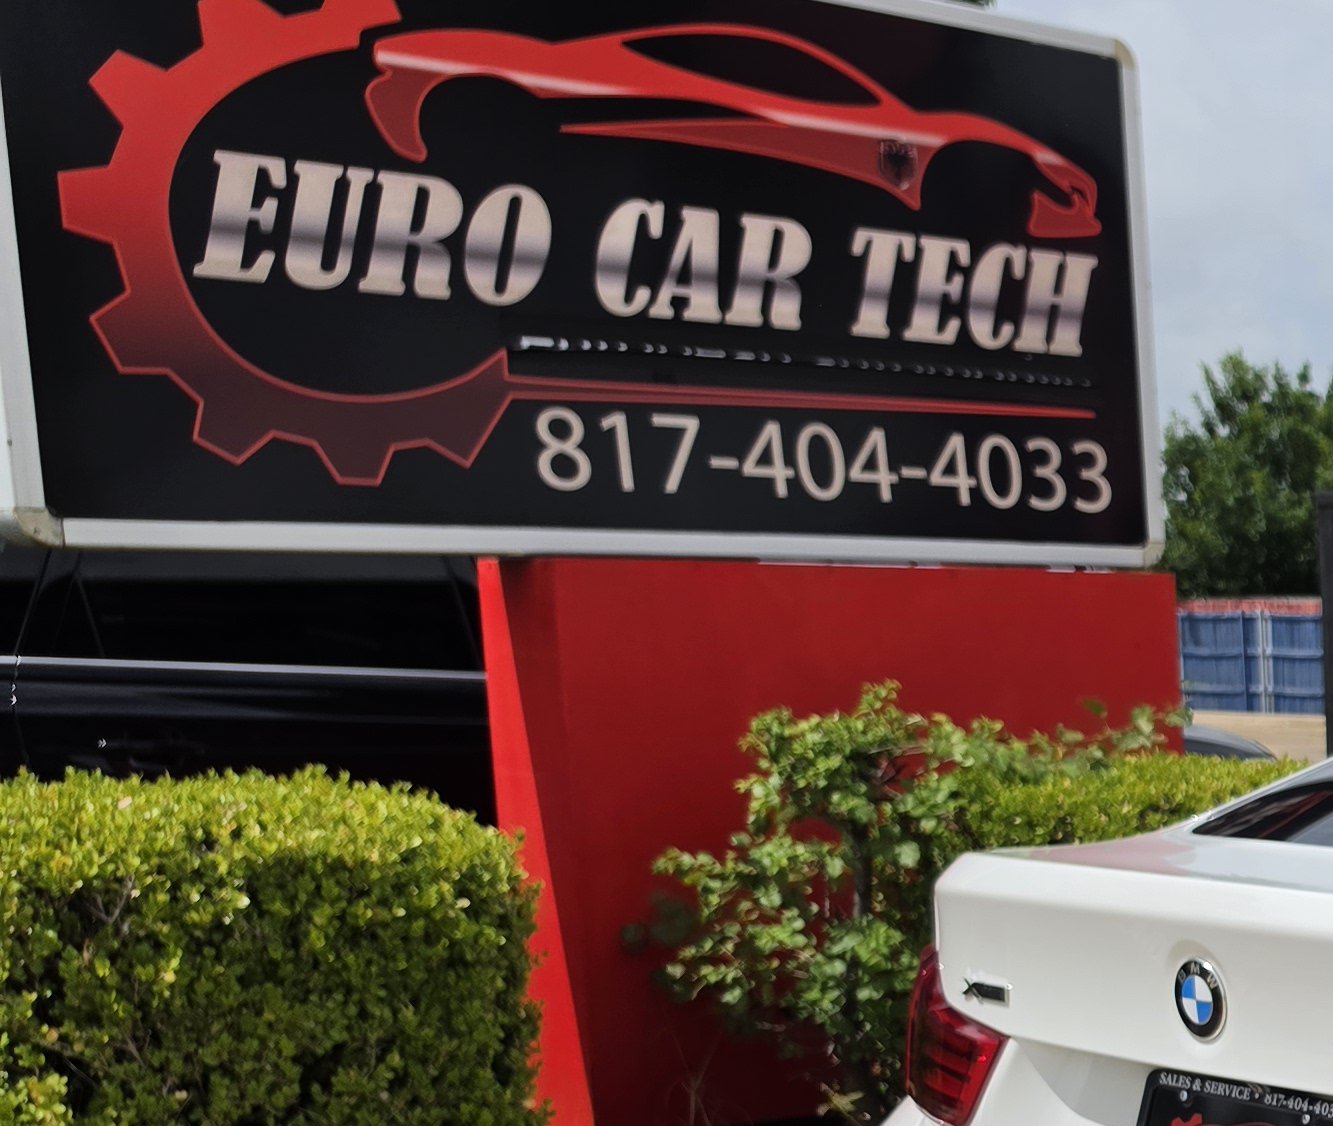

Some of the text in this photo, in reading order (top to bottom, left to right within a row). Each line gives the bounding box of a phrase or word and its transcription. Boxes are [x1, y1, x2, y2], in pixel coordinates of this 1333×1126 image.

[193, 149, 1098, 357] EURO CAR TECH
[535, 406, 1112, 514] 817-404-4033
[1178, 961, 1219, 990] BMW
[1159, 1071, 1192, 1090] SALES
[1192, 1079, 1201, 1092] &
[1203, 1080, 1251, 1101] SERVICE
